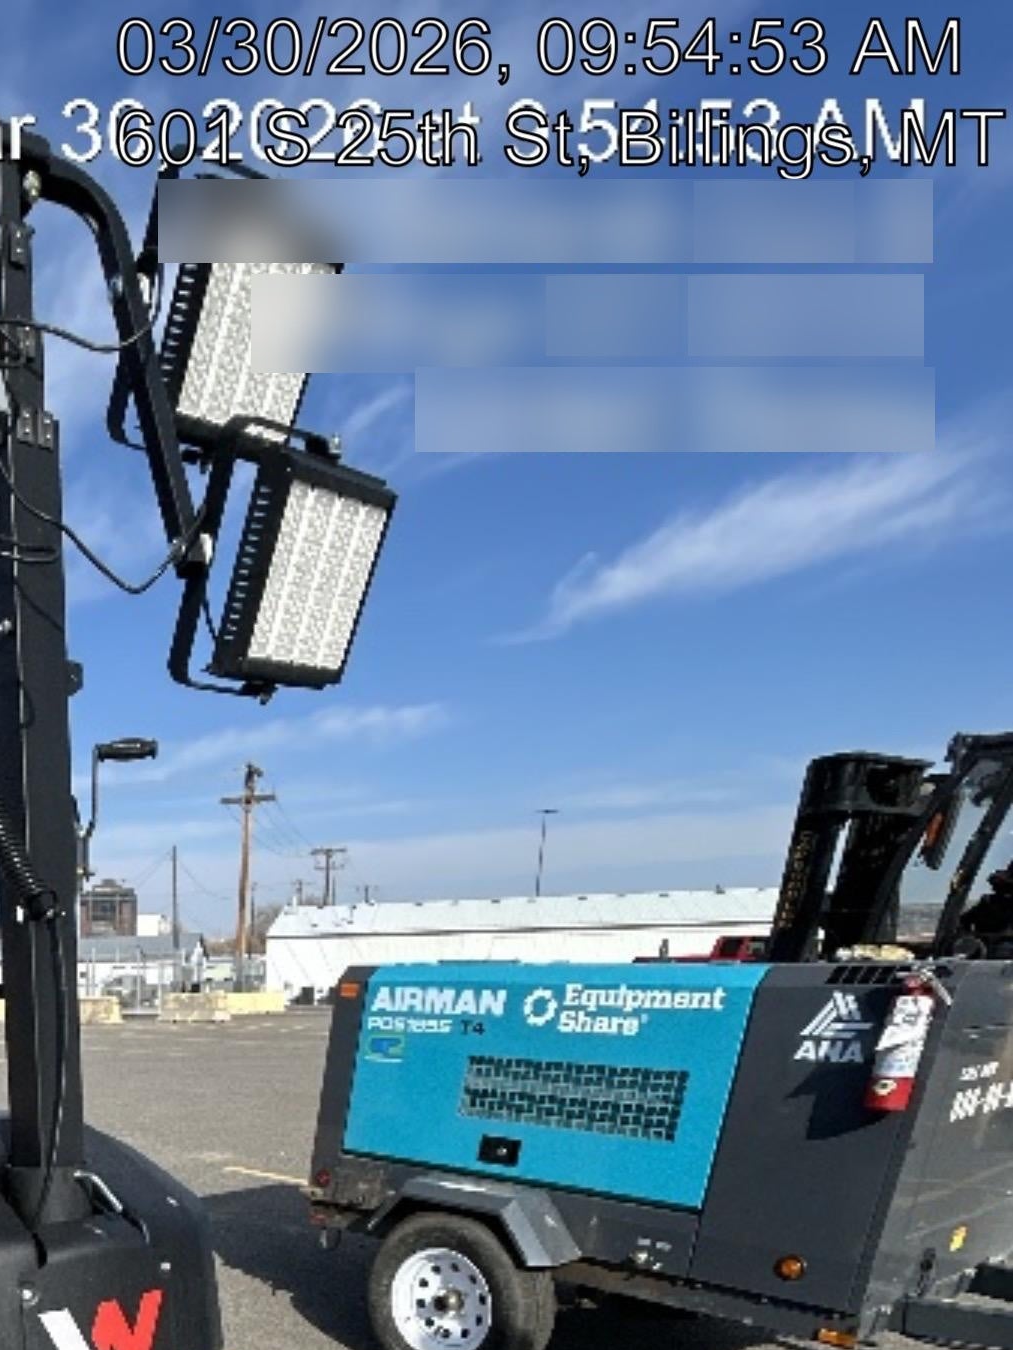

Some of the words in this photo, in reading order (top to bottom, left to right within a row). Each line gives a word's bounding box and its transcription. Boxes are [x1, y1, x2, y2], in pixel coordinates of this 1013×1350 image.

[370, 986, 507, 1017] AIRMAN
[562, 983, 727, 1012] Equipment
[556, 1010, 639, 1036] Share
